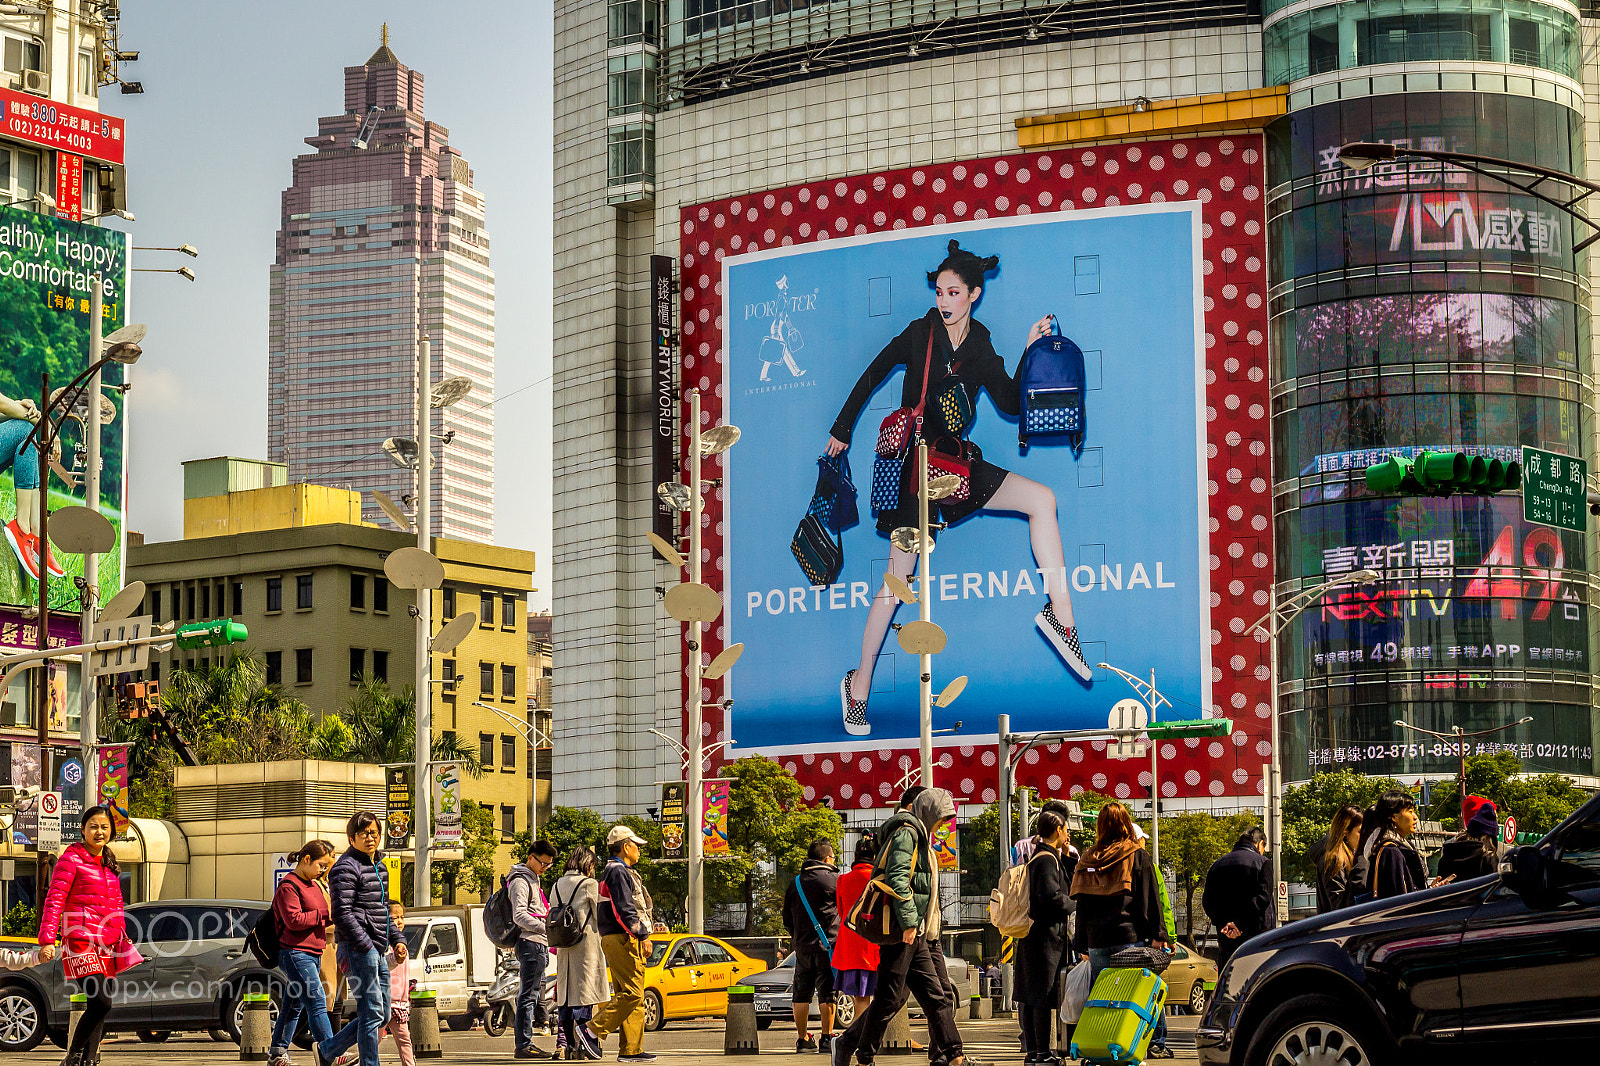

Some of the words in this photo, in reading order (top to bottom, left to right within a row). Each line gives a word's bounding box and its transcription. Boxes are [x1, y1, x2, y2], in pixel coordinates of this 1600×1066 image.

[9, 118, 92, 150] (02)2314-4003
[55, 231, 119, 272] Happy.
[744, 381, 817, 396] INTERNATIONAL
[1530, 453, 1581, 484] 成都路
[1461, 525, 1566, 620] 49
[747, 580, 871, 618] PORTER
[71, 954, 97, 967] MICKEY
[76, 963, 101, 976] MOUSE
